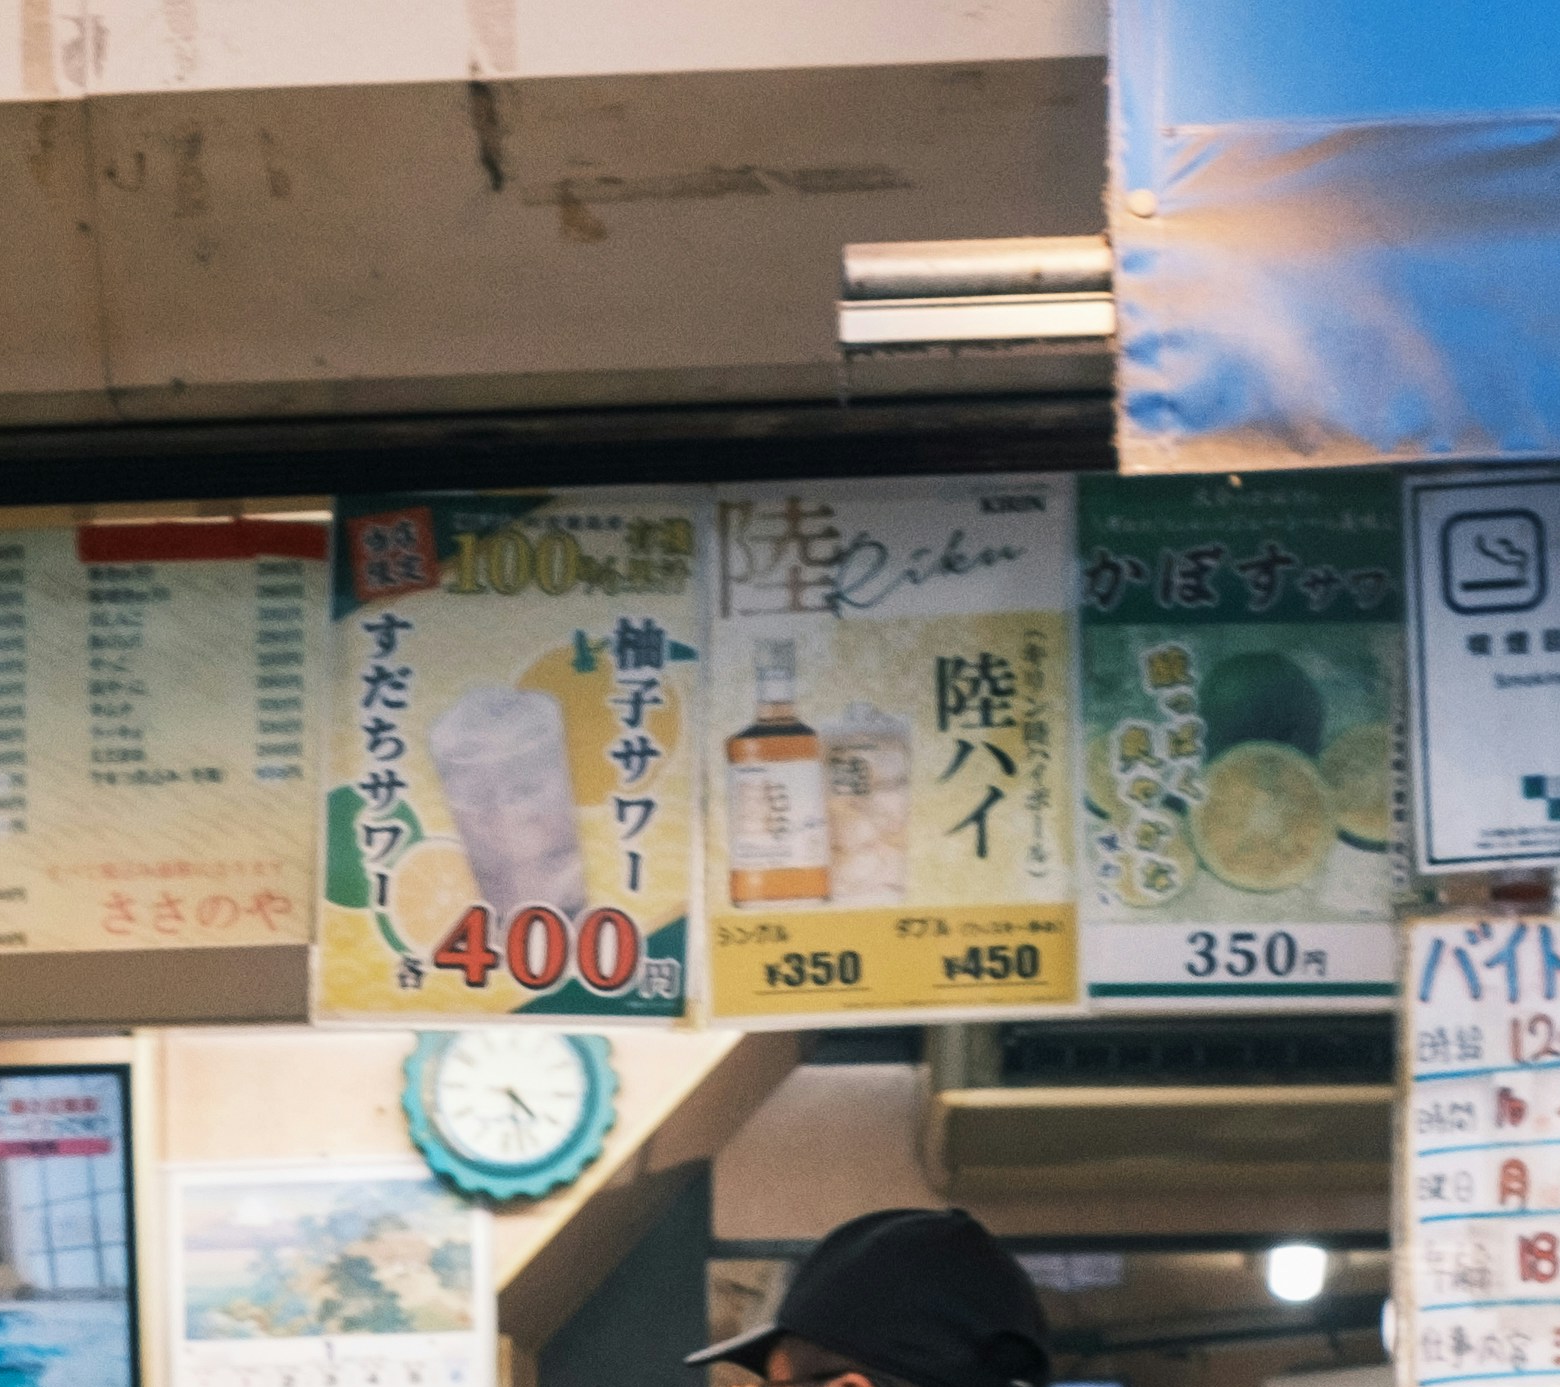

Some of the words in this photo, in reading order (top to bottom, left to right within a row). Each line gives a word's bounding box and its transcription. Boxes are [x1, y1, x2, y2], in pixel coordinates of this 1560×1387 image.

[717, 496, 838, 617] 陸
[360, 613, 414, 908] すだちサワー
[610, 616, 666, 892] 柚子サワー
[935, 652, 1018, 858] 陸ハイ
[103, 891, 291, 937] ささのや
[1185, 930, 1328, 978] 350円
[765, 950, 863, 988] ¥350
[944, 943, 1041, 982] ¥450
